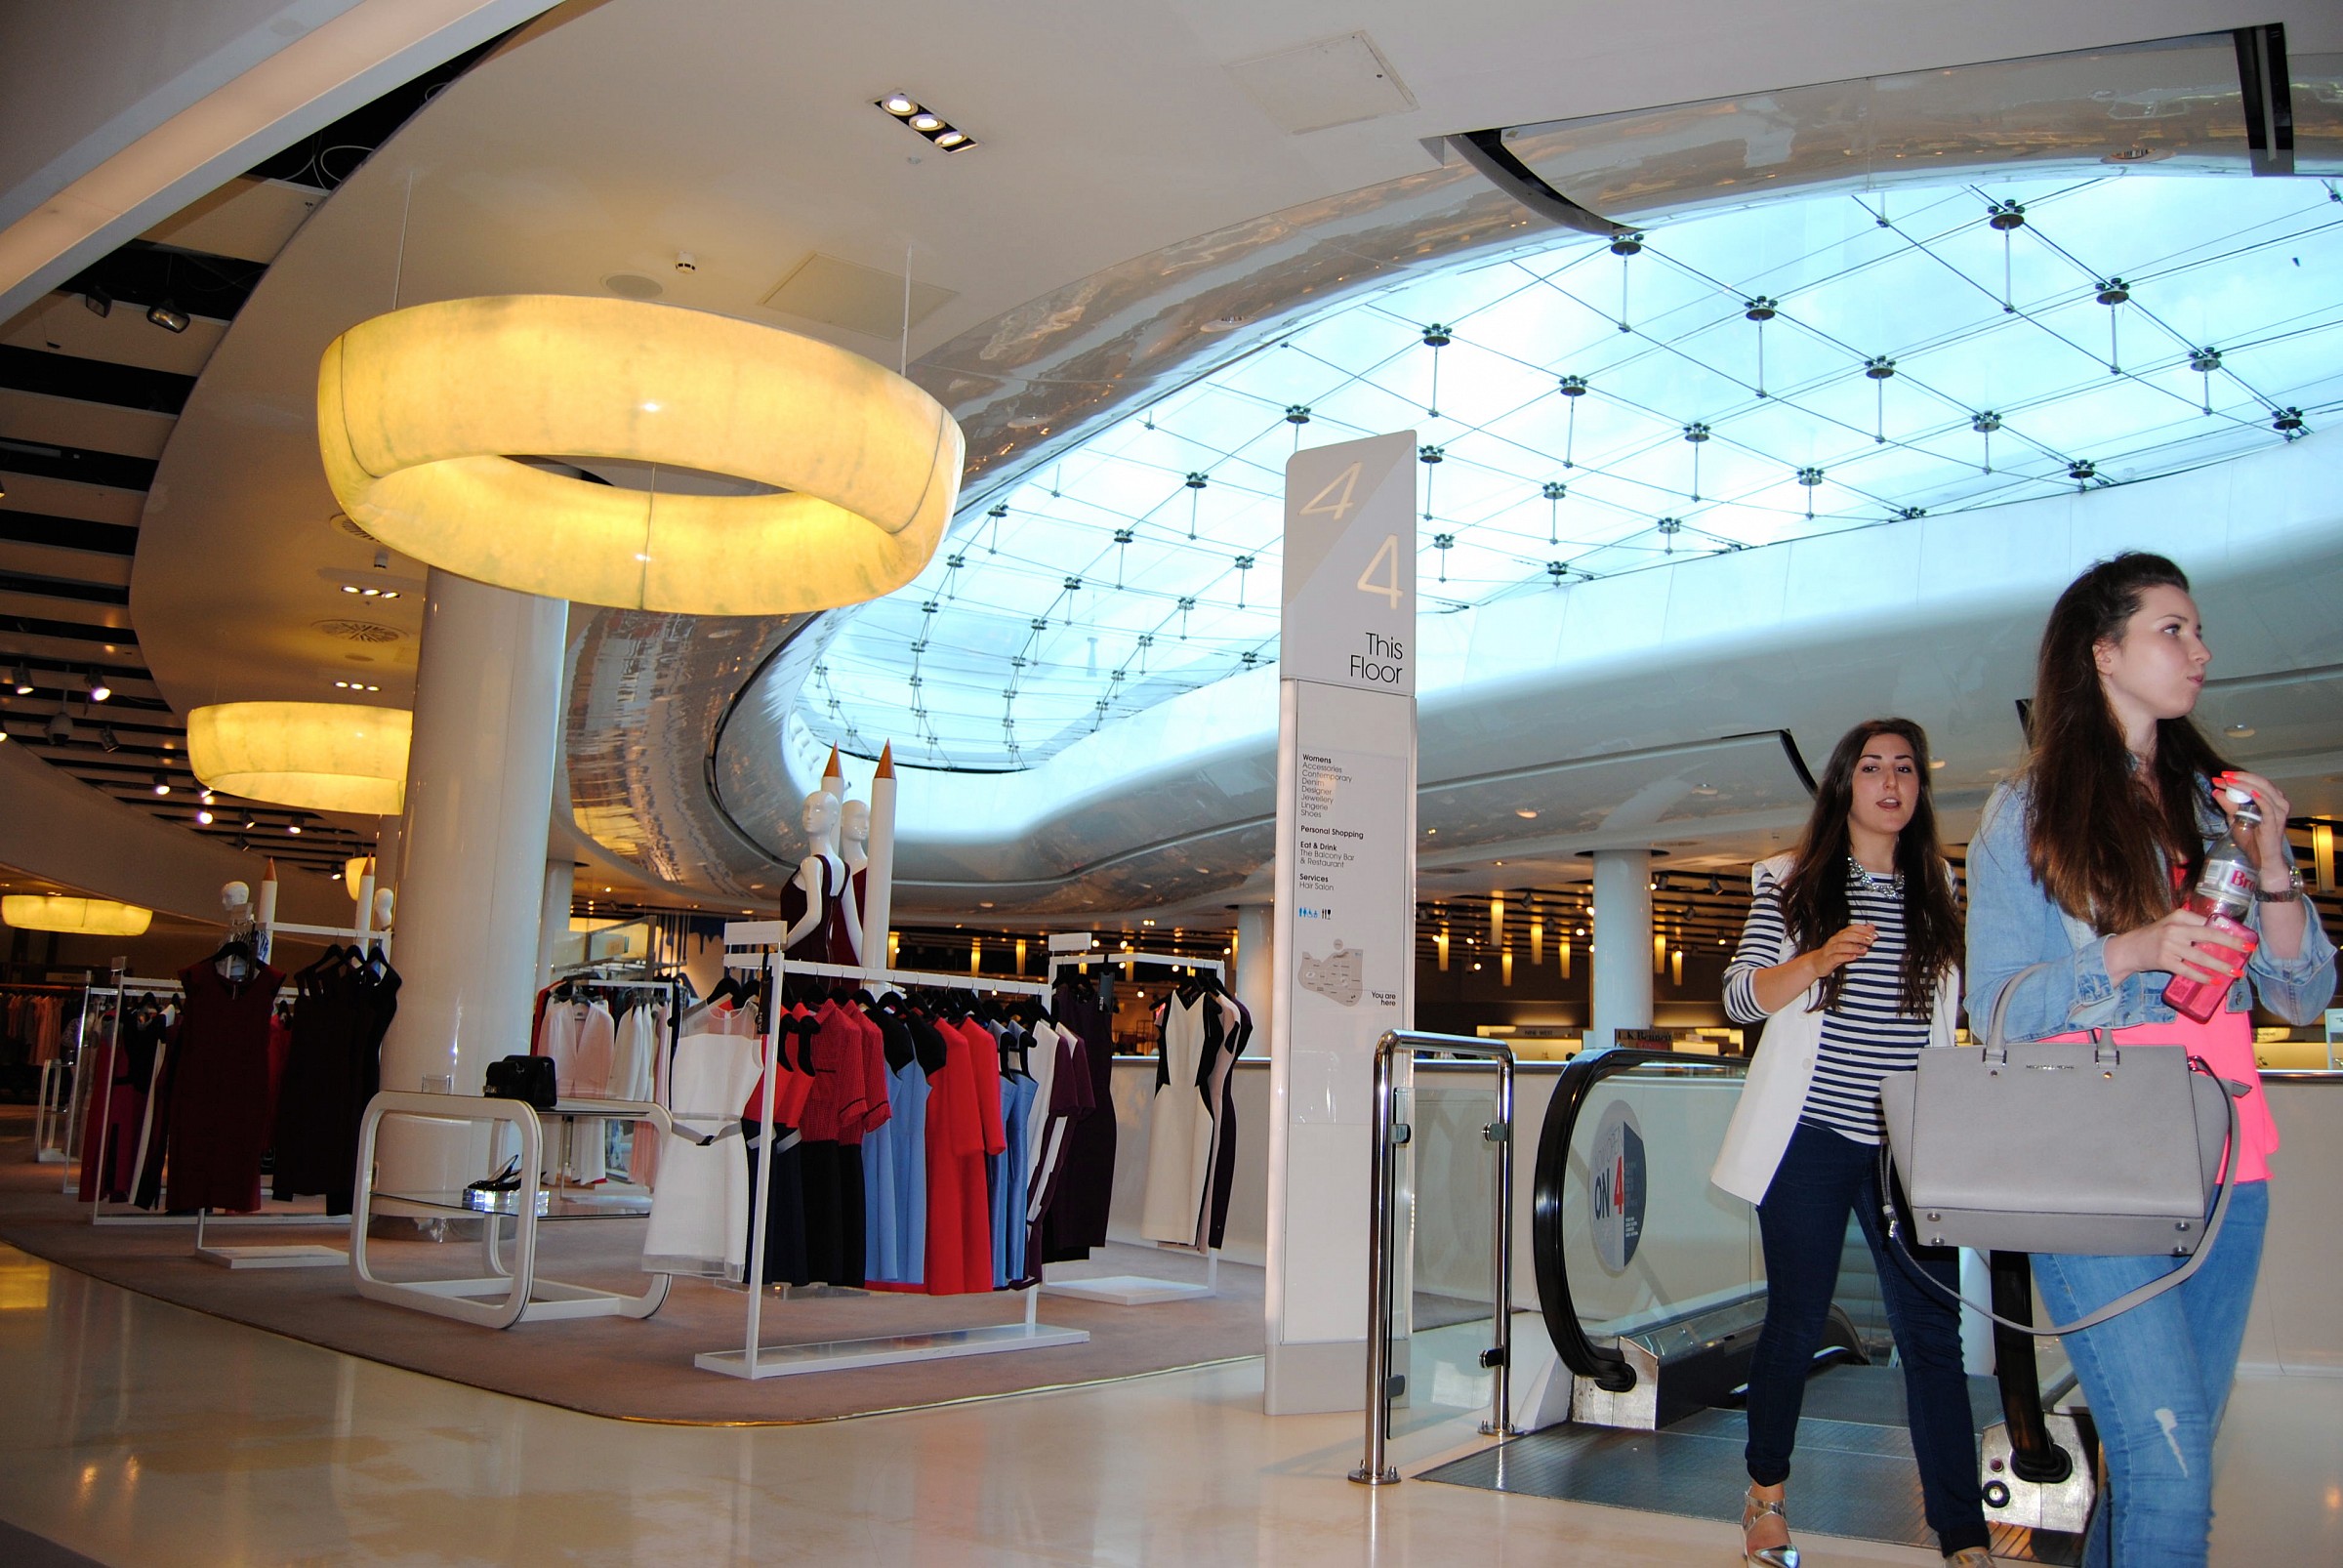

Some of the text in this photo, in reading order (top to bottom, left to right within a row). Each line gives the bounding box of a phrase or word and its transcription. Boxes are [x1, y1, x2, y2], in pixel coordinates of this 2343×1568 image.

[1297, 461, 1364, 520] 4
[1356, 534, 1404, 610] 4
[1365, 632, 1404, 661] This
[1349, 654, 1404, 684] Floor
[1302, 754, 1332, 764] Womens
[1302, 762, 1342, 773] Accessories
[1301, 769, 1353, 783] Contemporary
[1301, 777, 1325, 787] Denim
[1301, 785, 1333, 796] Designer
[1301, 794, 1334, 805] Jewellery
[1300, 802, 1329, 811] Lingerie
[1300, 809, 1322, 818] Shoes
[1300, 825, 1364, 840] Personal Shopping
[1320, 843, 1337, 851] Drink
[1300, 848, 1355, 861] The Balcony Bar
[1307, 857, 1344, 868] Restaurant
[1299, 873, 1329, 883] Services
[1314, 882, 1335, 891] Salon
[1371, 991, 1384, 1000] You
[1594, 1167, 1610, 1220] ON
[1613, 1155, 1624, 1215] 4
